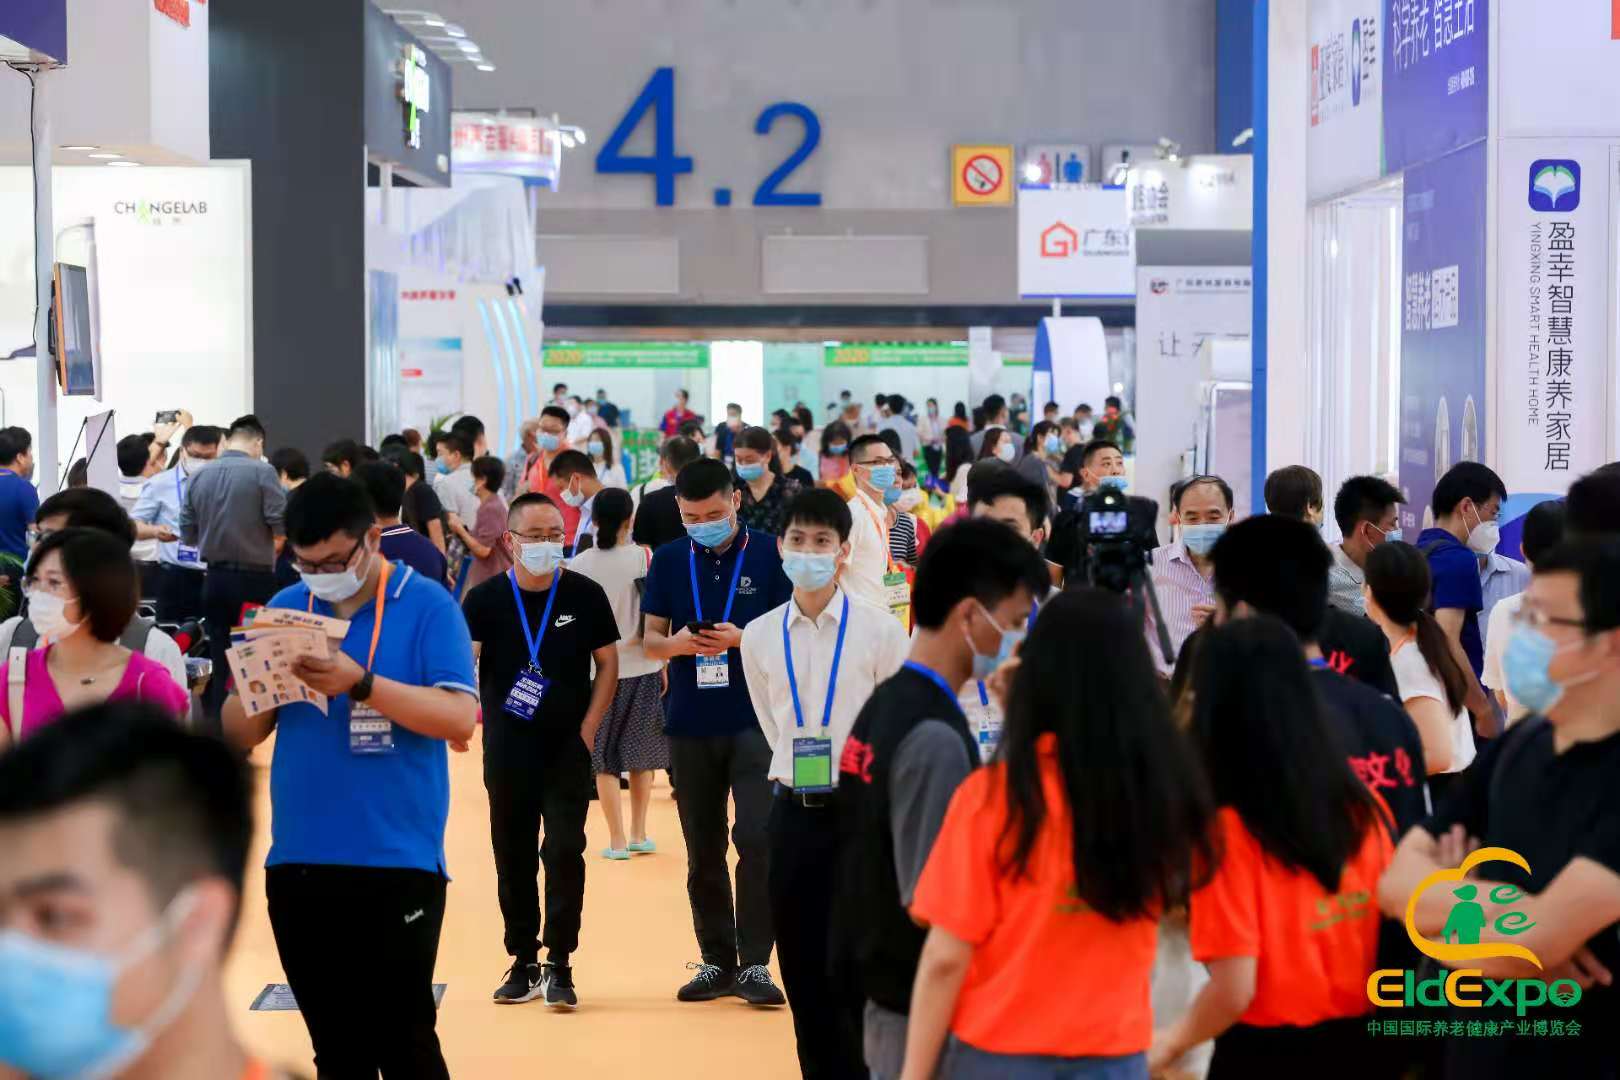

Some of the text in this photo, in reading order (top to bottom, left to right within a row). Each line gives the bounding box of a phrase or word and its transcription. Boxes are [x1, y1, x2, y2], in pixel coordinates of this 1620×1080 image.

[595, 67, 823, 207] 4.2
[1083, 228, 1130, 247] 广东
[1528, 222, 1542, 426] YINGXING SMART HEALTH HOME
[1545, 221, 1576, 471] 盈幸智慧康养家居
